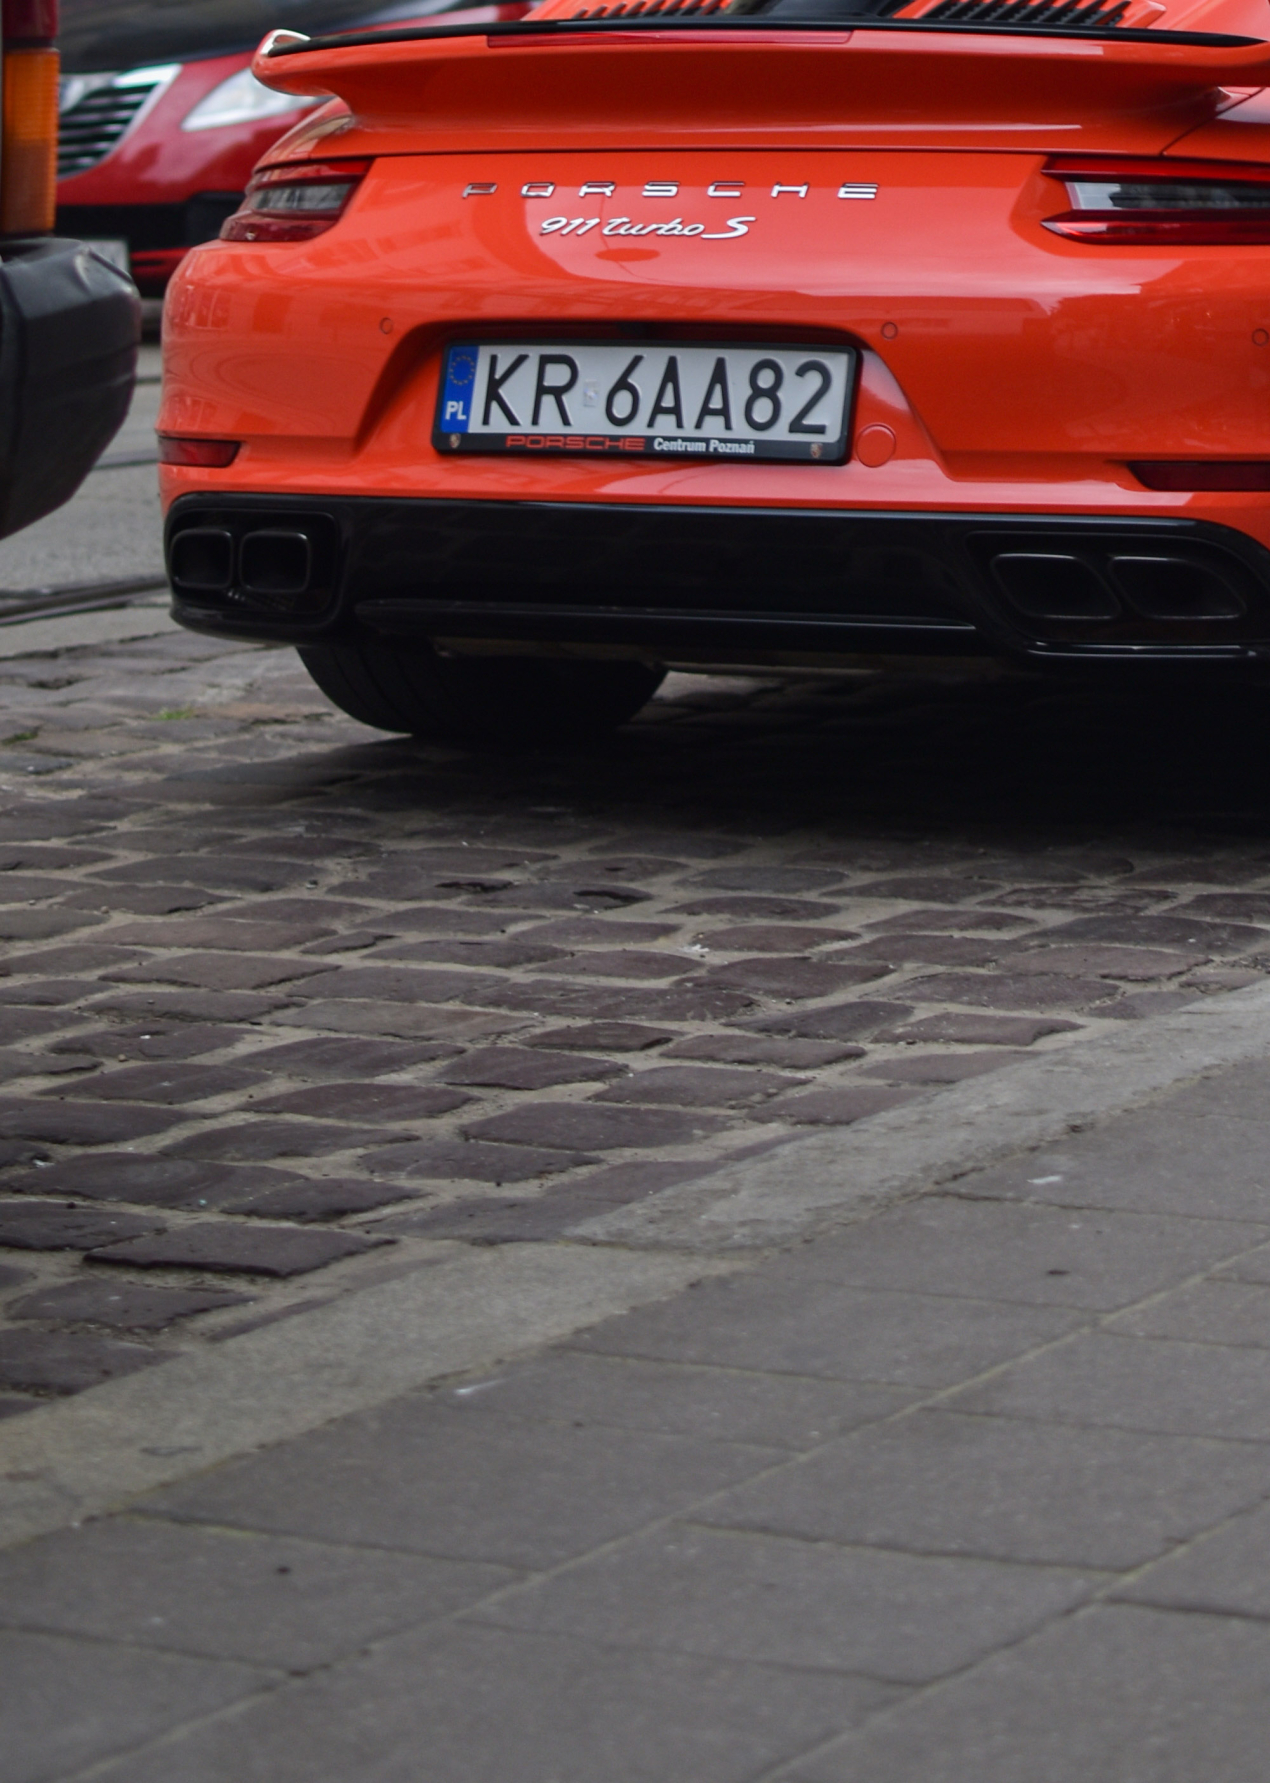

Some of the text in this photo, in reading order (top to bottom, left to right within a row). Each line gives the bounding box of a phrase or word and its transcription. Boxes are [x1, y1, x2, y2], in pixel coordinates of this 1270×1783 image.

[462, 181, 879, 200] PORSCHE
[540, 216, 757, 239] 911 turbo S
[481, 353, 833, 436] KR 6AA82
[445, 401, 467, 421] PL
[505, 434, 755, 455] PORSCHE Centrum Poznań
